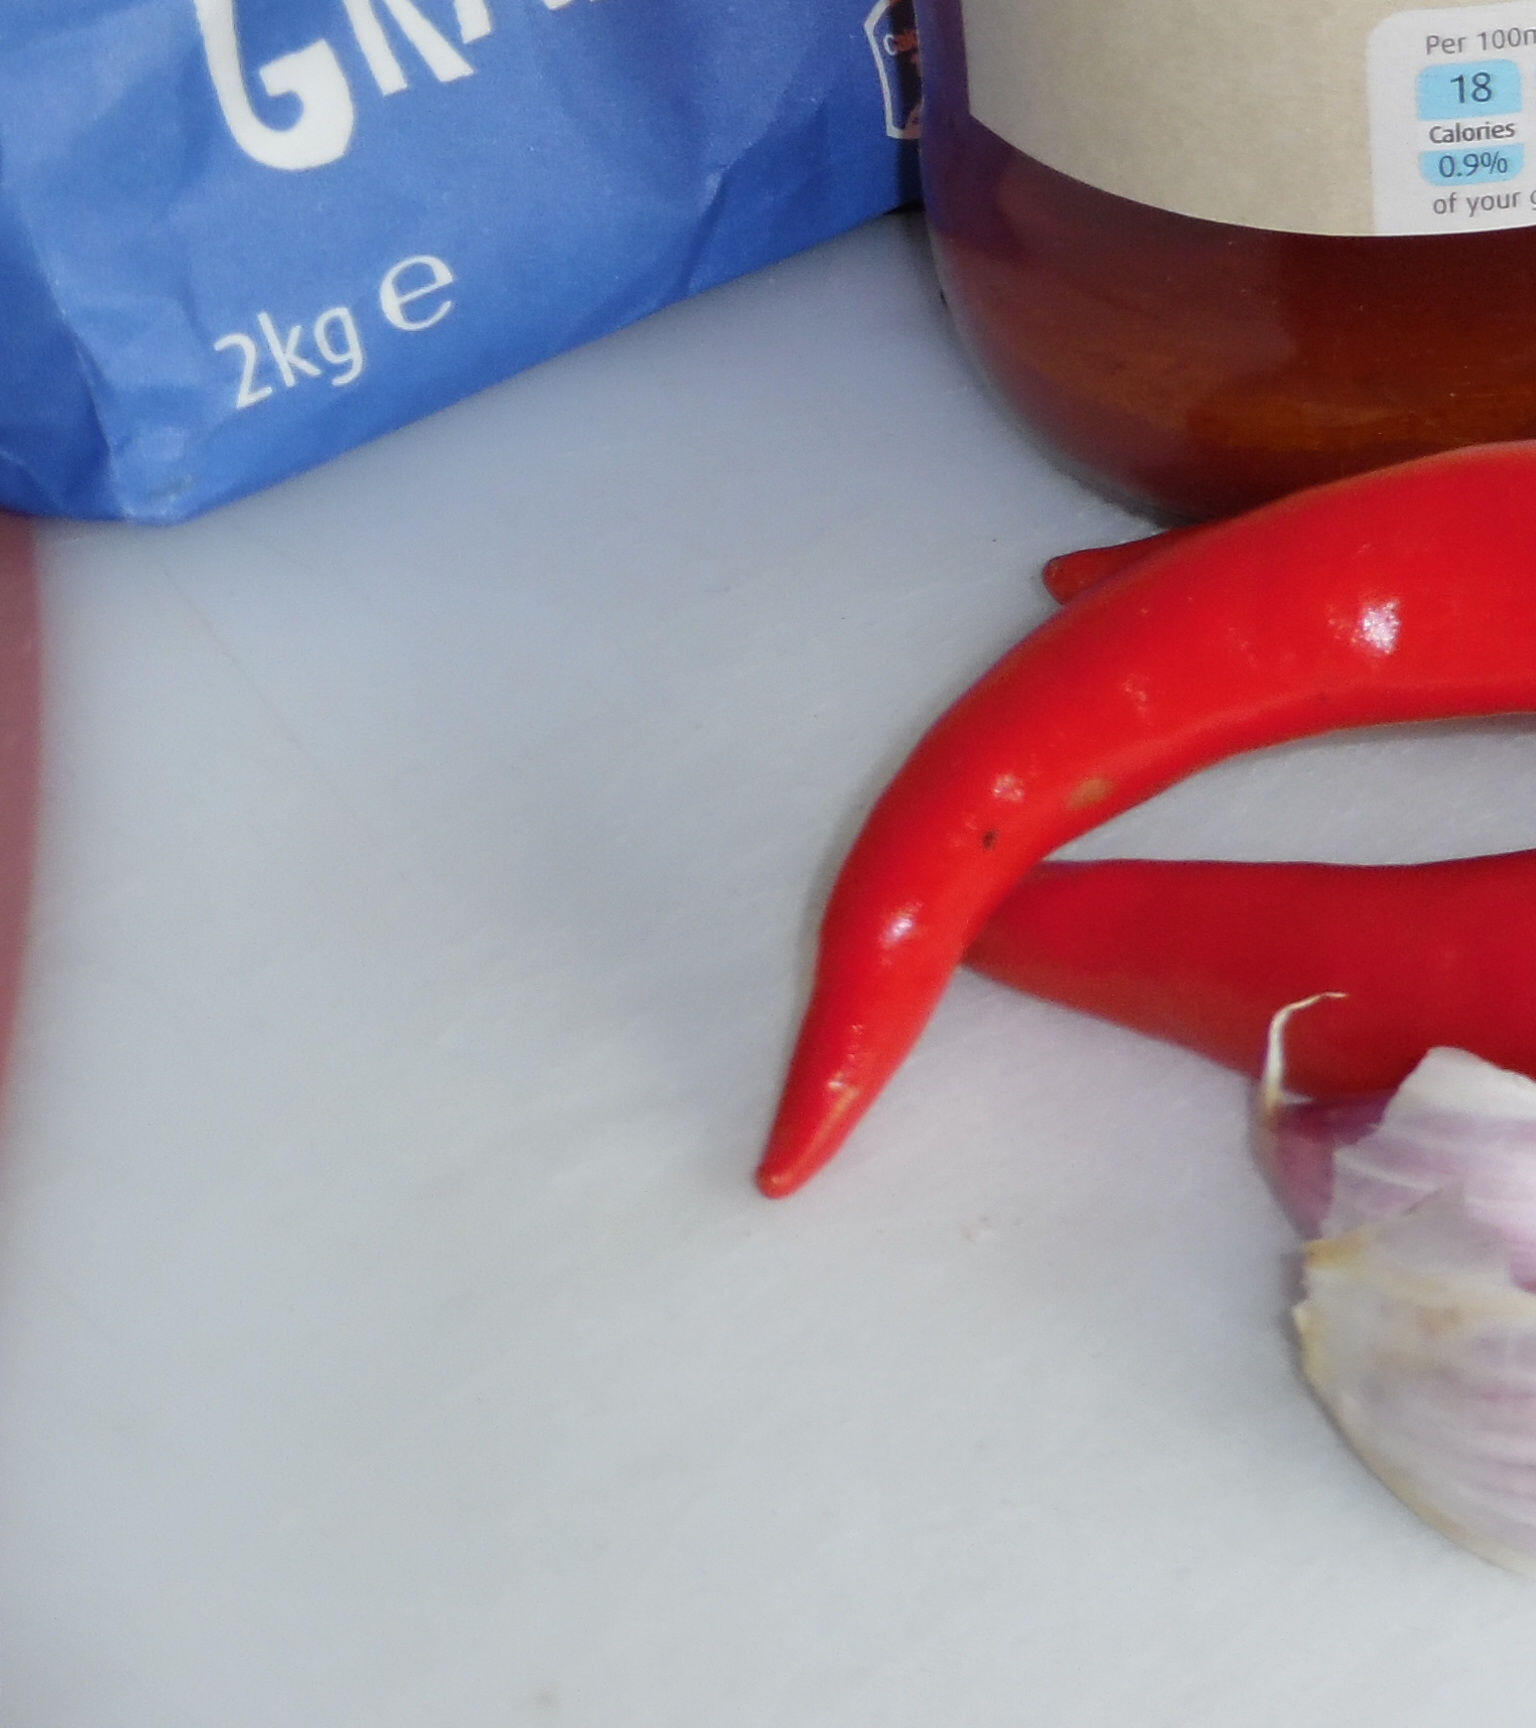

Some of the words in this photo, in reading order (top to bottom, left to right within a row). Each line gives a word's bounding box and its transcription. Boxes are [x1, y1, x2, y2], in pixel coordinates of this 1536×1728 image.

[1426, 35, 1467, 55] Per
[1450, 71, 1492, 104] 18
[1429, 121, 1516, 145] Calories
[1438, 150, 1508, 179] 0.9%
[1432, 191, 1458, 215] of
[1466, 188, 1521, 218] your
[213, 302, 366, 409] 2kg
